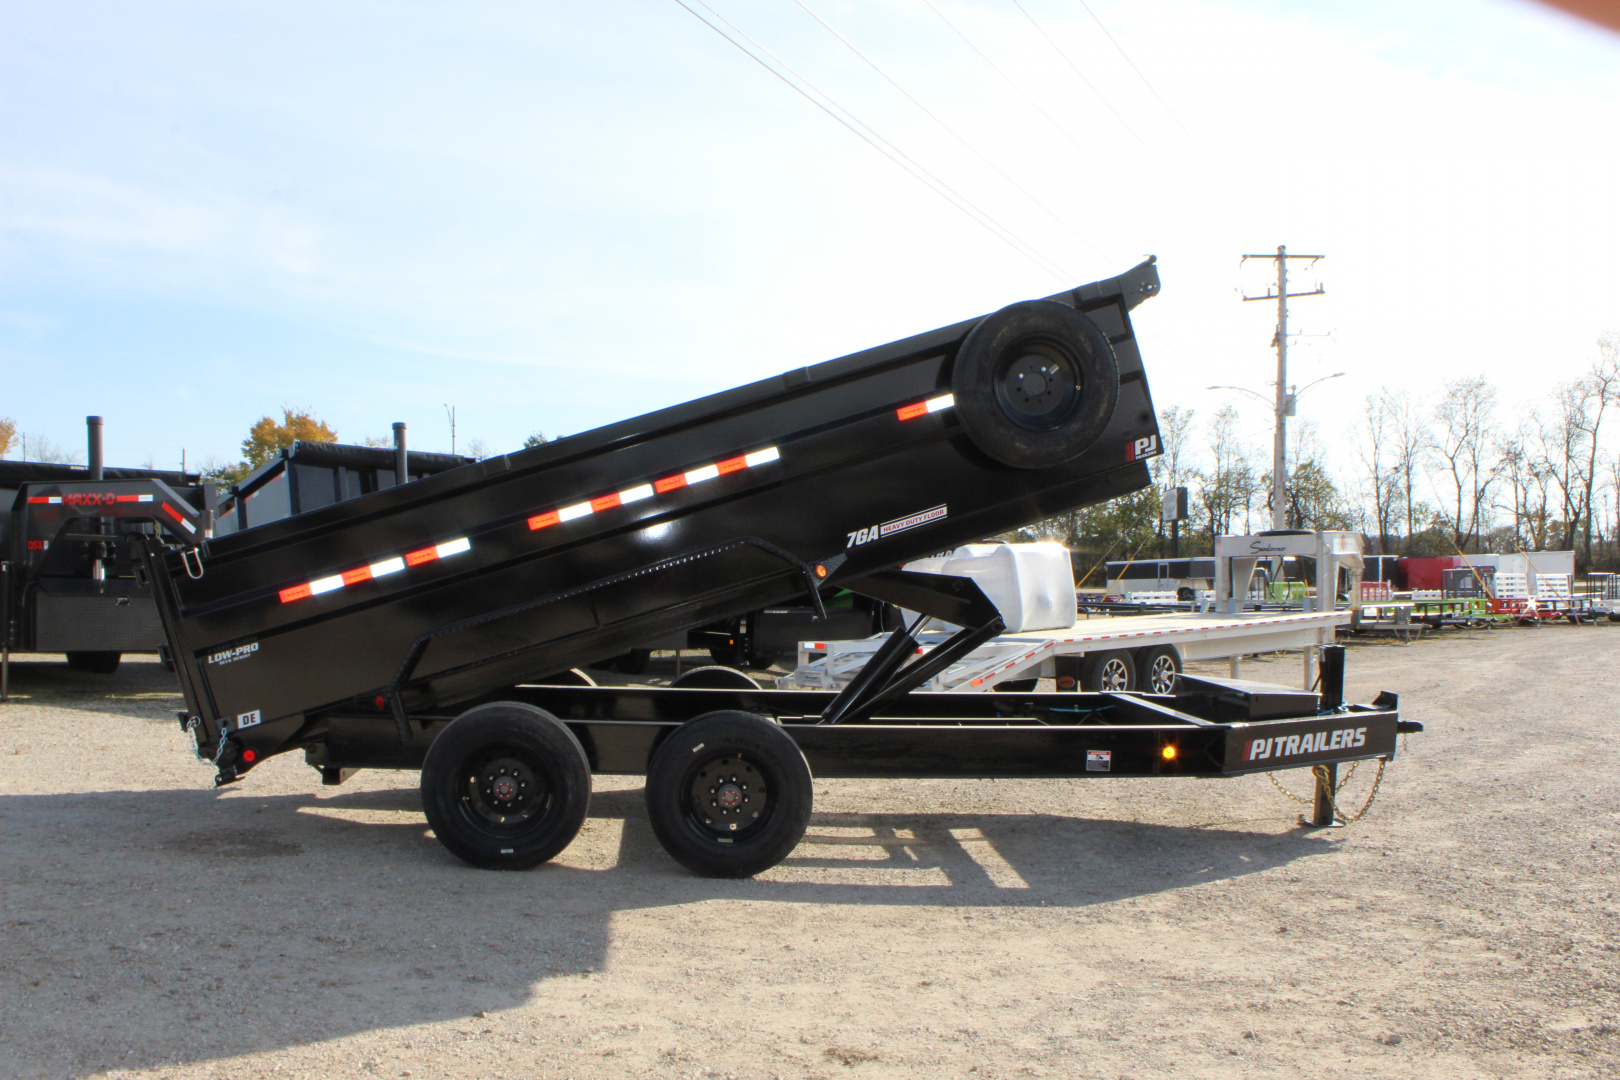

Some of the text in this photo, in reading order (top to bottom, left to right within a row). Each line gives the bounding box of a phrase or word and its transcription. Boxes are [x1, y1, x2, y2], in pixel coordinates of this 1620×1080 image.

[1134, 434, 1157, 456] PJ
[846, 509, 945, 549] 7GA HEAVY DUTY FLOOR
[207, 642, 260, 664] LOW-PRO
[242, 713, 256, 726] DE
[1274, 727, 1368, 758] TRAILERS
